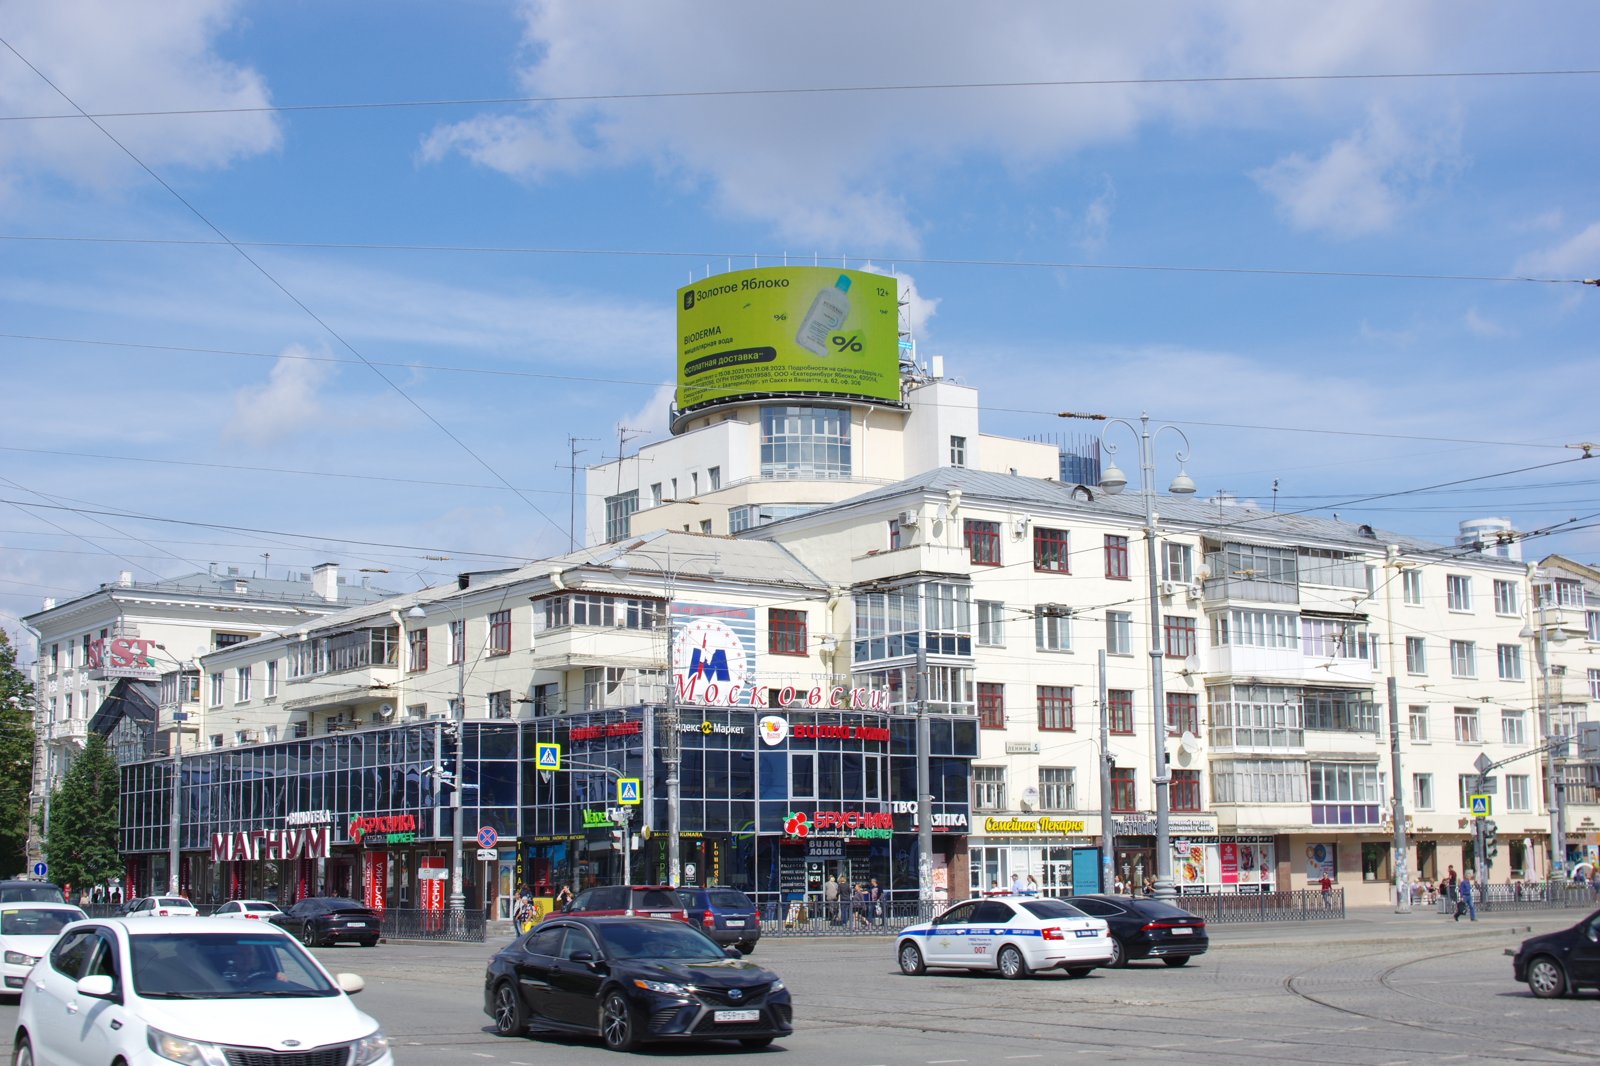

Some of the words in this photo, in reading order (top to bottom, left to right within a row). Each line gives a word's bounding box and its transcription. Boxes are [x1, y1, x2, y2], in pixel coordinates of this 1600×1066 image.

[696, 283, 738, 302] Золотое
[741, 277, 790, 291] Яблоко
[876, 287, 889, 297] 12+
[684, 325, 722, 345] BIODERMA
[718, 337, 734, 345] вода
[788, 364, 828, 372] Подробности
[713, 722, 745, 735] Маркет
[813, 811, 894, 829] БРУСНИКА
[985, 816, 1037, 832] Семейная
[1038, 816, 1085, 835] Пекарня
[855, 828, 894, 840] МАРКЕТ
[210, 826, 332, 862] МАГНУМ
[808, 839, 842, 848] ВИЛКА
[808, 848, 842, 856] ЛОЖКА
[374, 861, 384, 912] БРУСНИКА
[974, 946, 987, 954] 007
